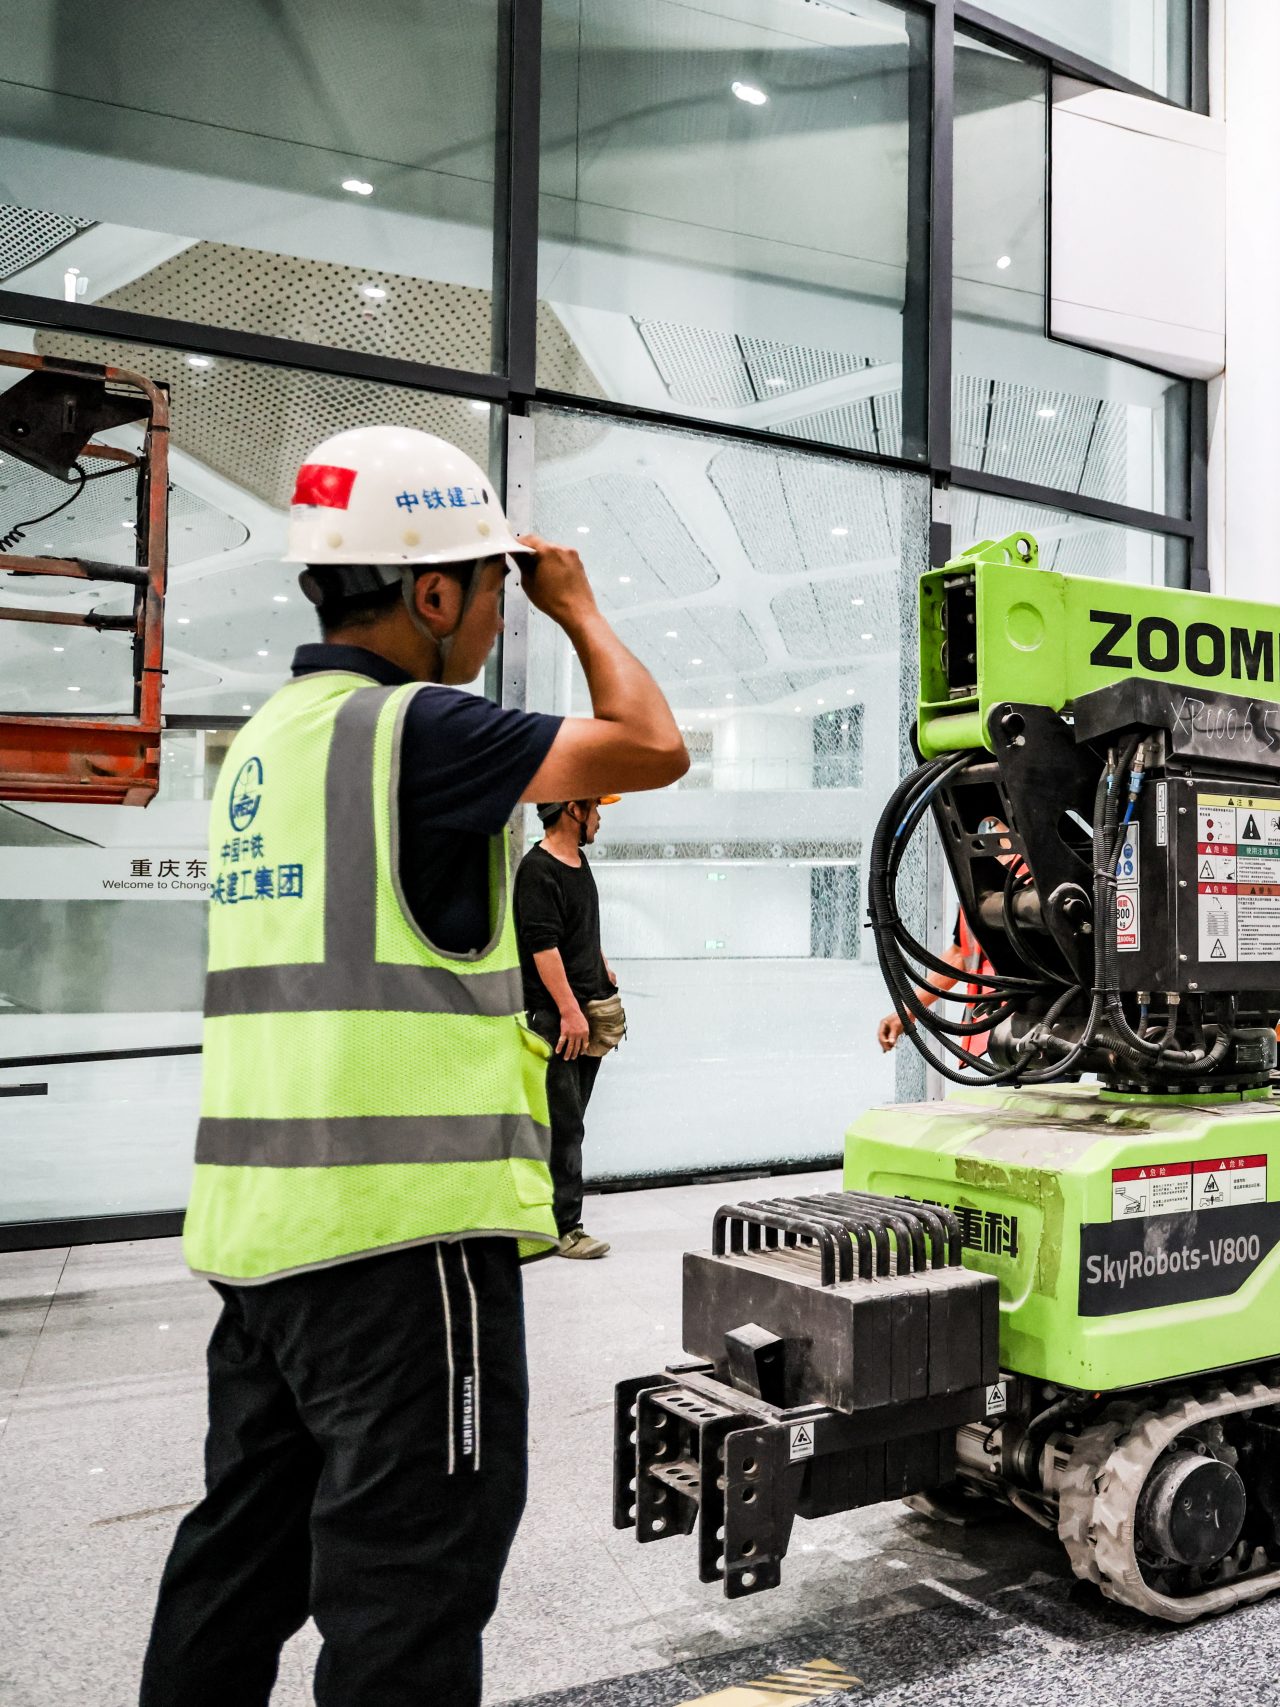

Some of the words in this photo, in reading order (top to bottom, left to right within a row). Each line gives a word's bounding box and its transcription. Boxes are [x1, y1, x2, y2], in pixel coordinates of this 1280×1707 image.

[130, 859, 207, 878] 重庆东
[102, 880, 154, 889] Welcome
[157, 880, 168, 889] to
[1229, 1160, 1245, 1168] 危险
[1150, 1167, 1166, 1177] 危险
[893, 1195, 1019, 1259] 重科
[1086, 1235, 1260, 1287] SkyRobots-V800
